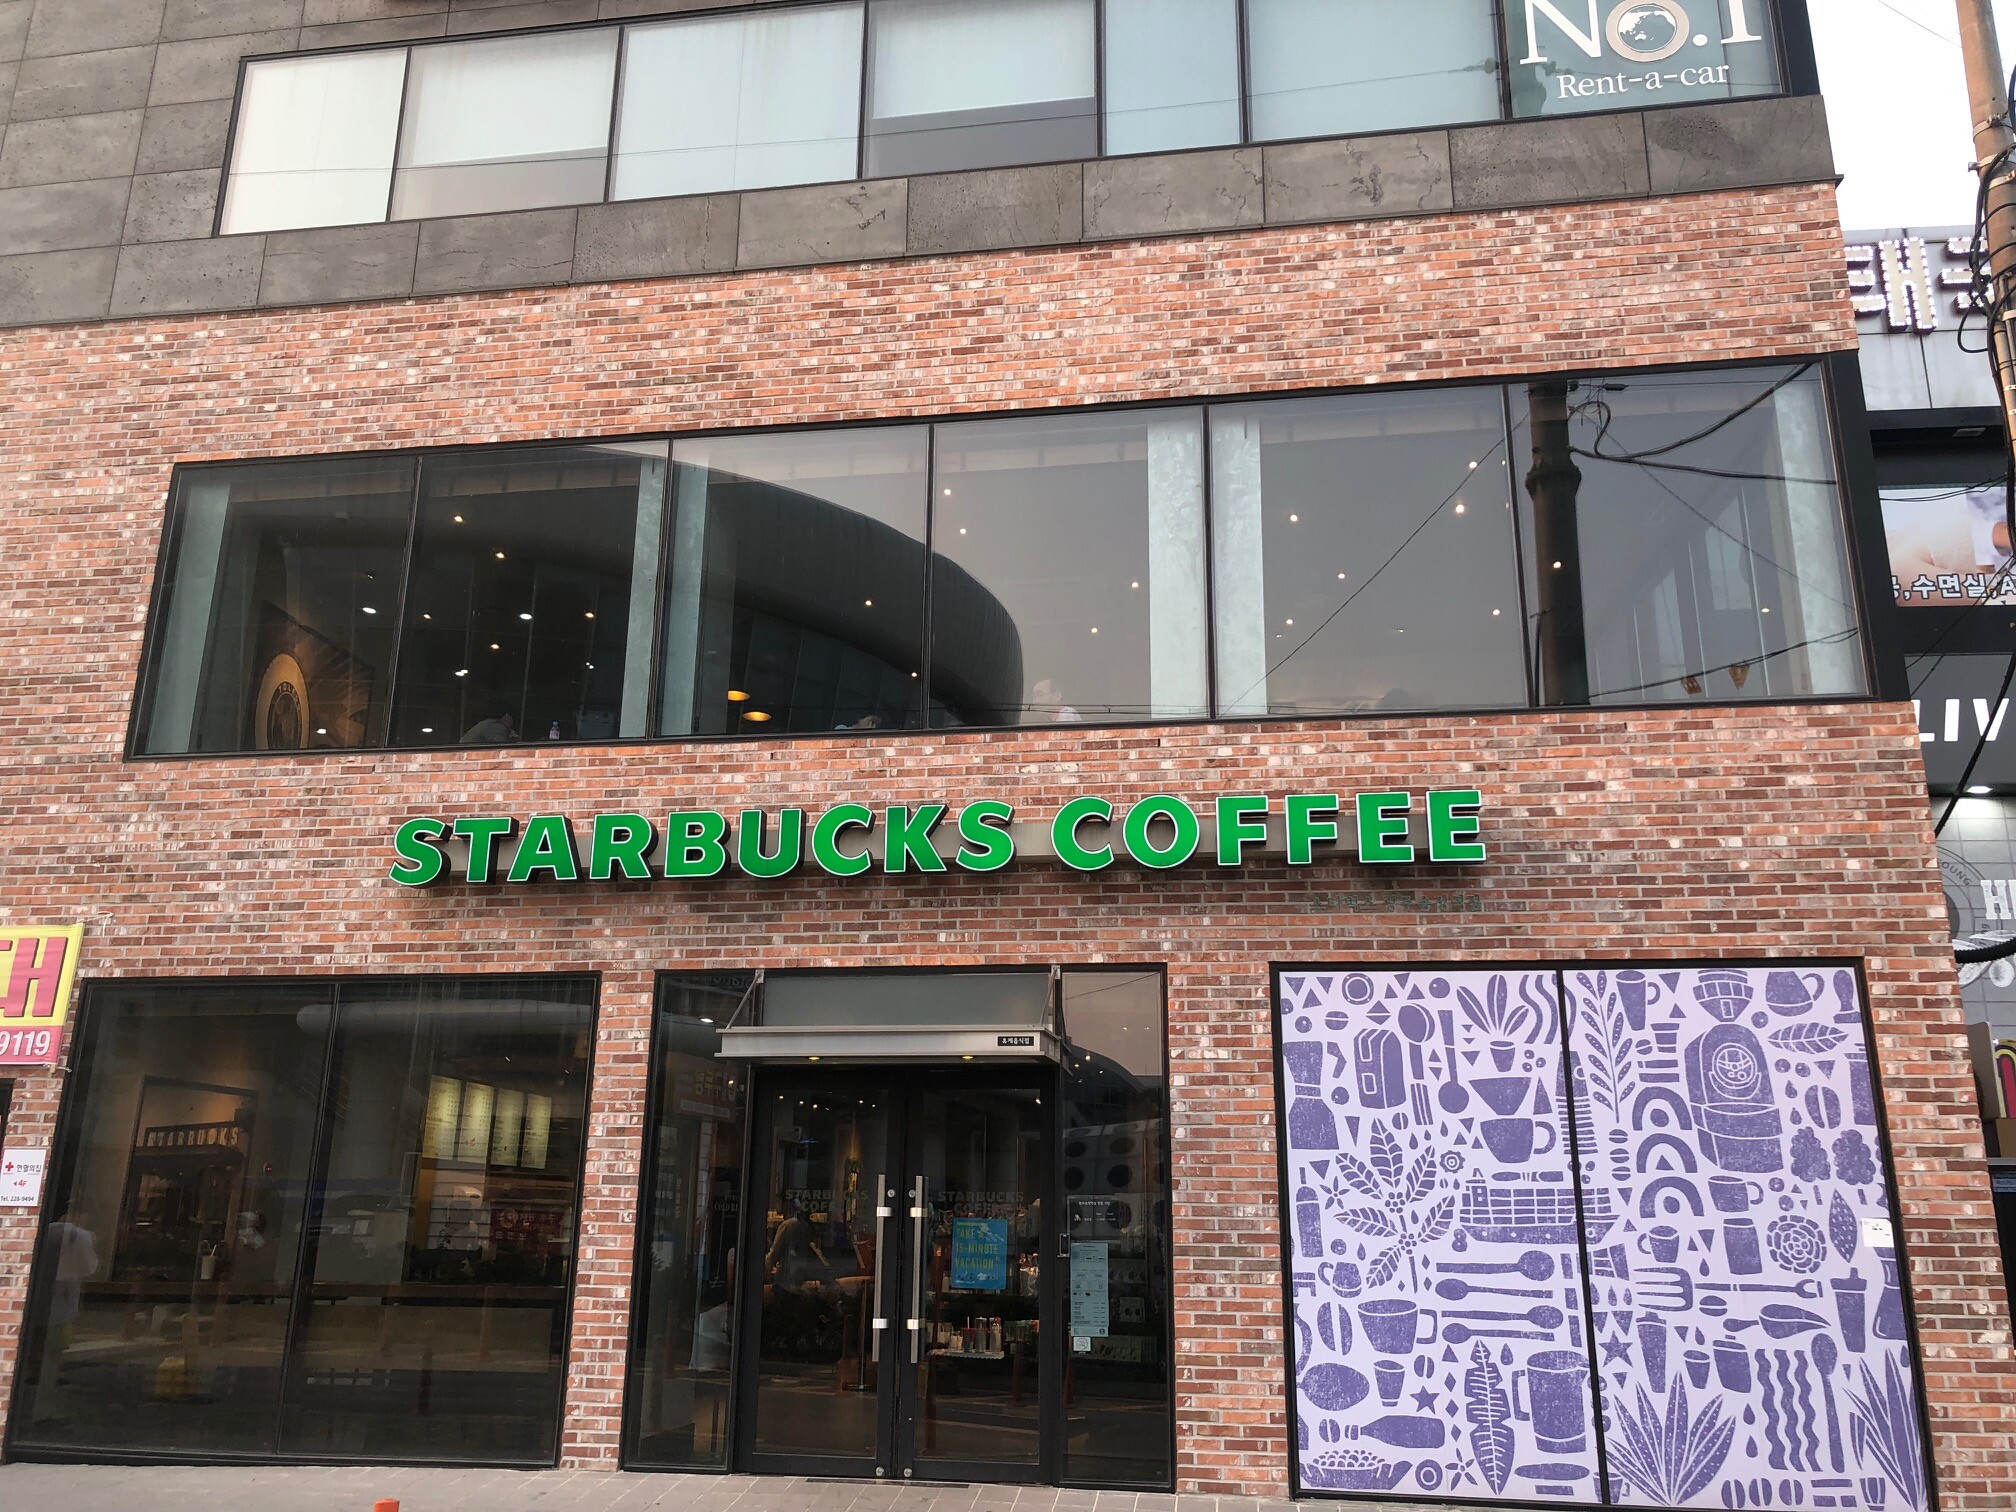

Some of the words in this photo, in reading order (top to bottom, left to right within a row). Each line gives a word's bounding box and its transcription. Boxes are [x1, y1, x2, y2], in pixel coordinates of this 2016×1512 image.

[1556, 63, 1729, 99] Rent-a-car
[388, 800, 1017, 886] STARBUCKS
[1050, 789, 1487, 871] COFFEE
[0, 1030, 51, 1056] 9119
[1001, 1037, 1030, 1045] 휴게음식점
[16, 1164, 42, 1173] 헌혈의집
[18, 1178, 27, 1188] 4F
[938, 1190, 1024, 1203] STARBUCKS
[955, 1243, 999, 1255] 15-MINUTE
[955, 1257, 994, 1270] VACATION
